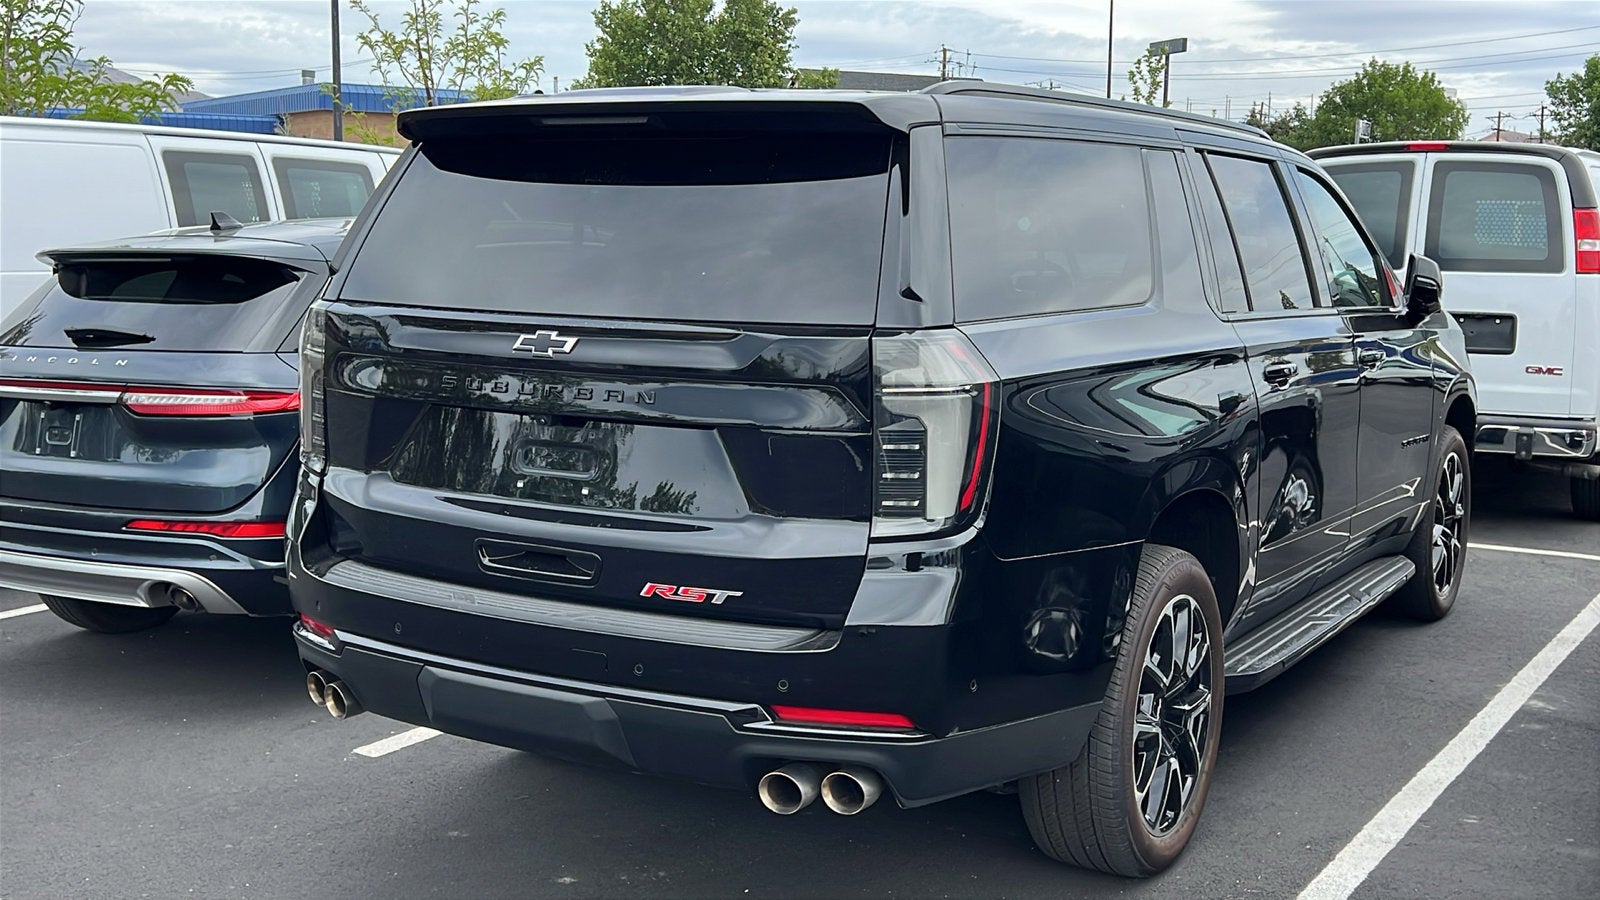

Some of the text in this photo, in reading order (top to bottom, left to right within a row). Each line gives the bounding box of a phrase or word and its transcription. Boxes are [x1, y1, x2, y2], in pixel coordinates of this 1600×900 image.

[0, 355, 128, 366] INCOLN
[1525, 365, 1564, 377] GMC
[441, 375, 658, 406] SUBURBAN
[640, 582, 744, 605] RST
